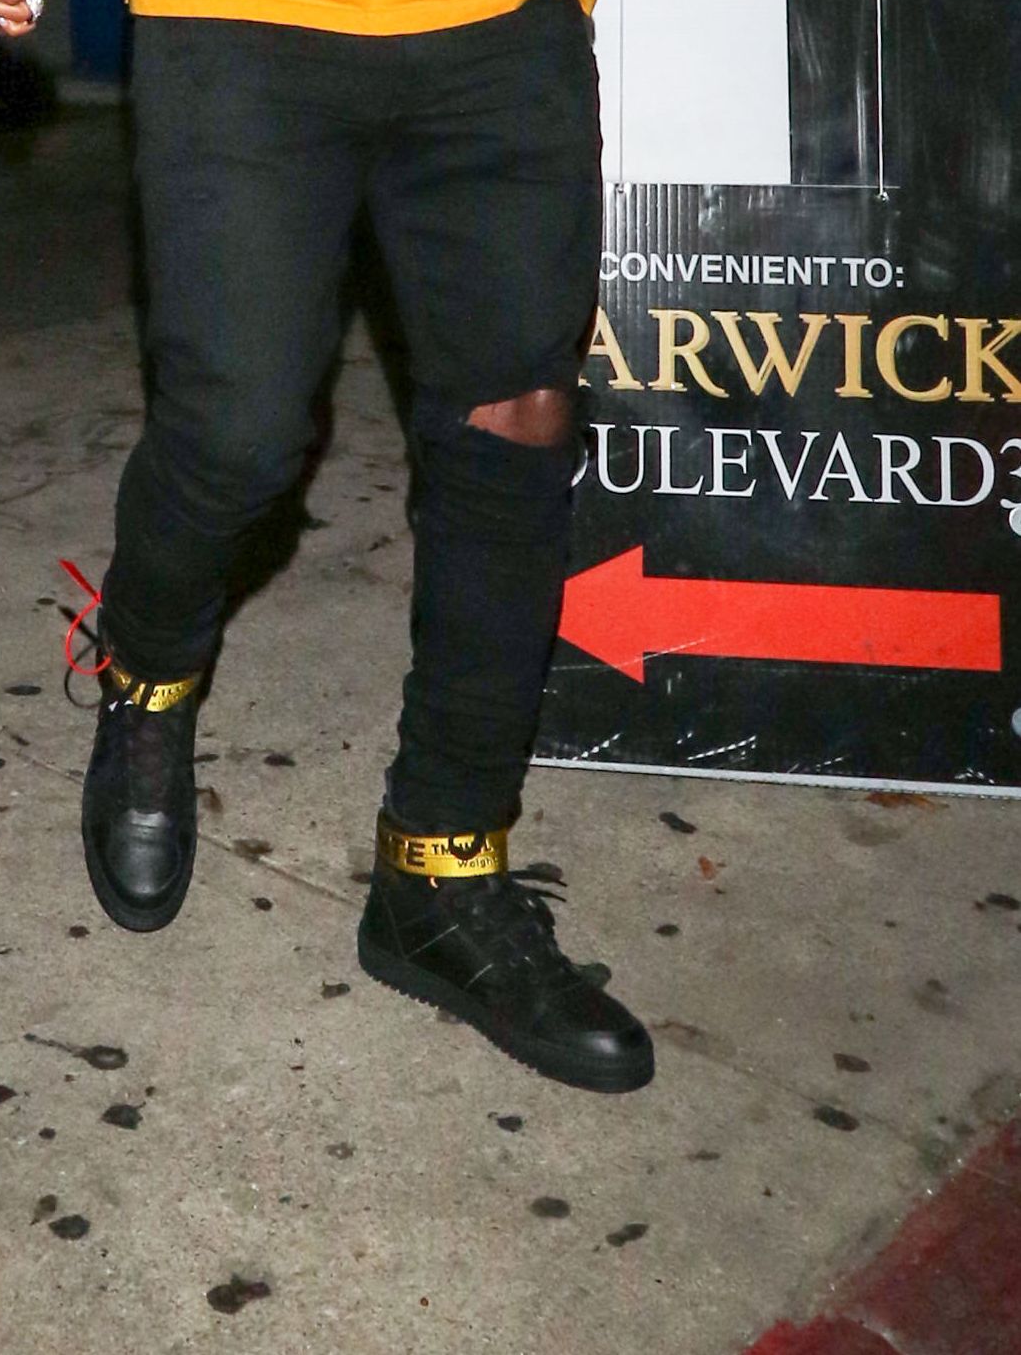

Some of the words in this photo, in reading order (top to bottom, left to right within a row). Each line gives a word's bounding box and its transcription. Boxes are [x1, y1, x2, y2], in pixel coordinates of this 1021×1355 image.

[599, 251, 836, 287] CONVENIENT
[842, 257, 904, 289] TO:
[578, 305, 1021, 402] ARWICK
[571, 423, 1021, 510] ULEVARD3
